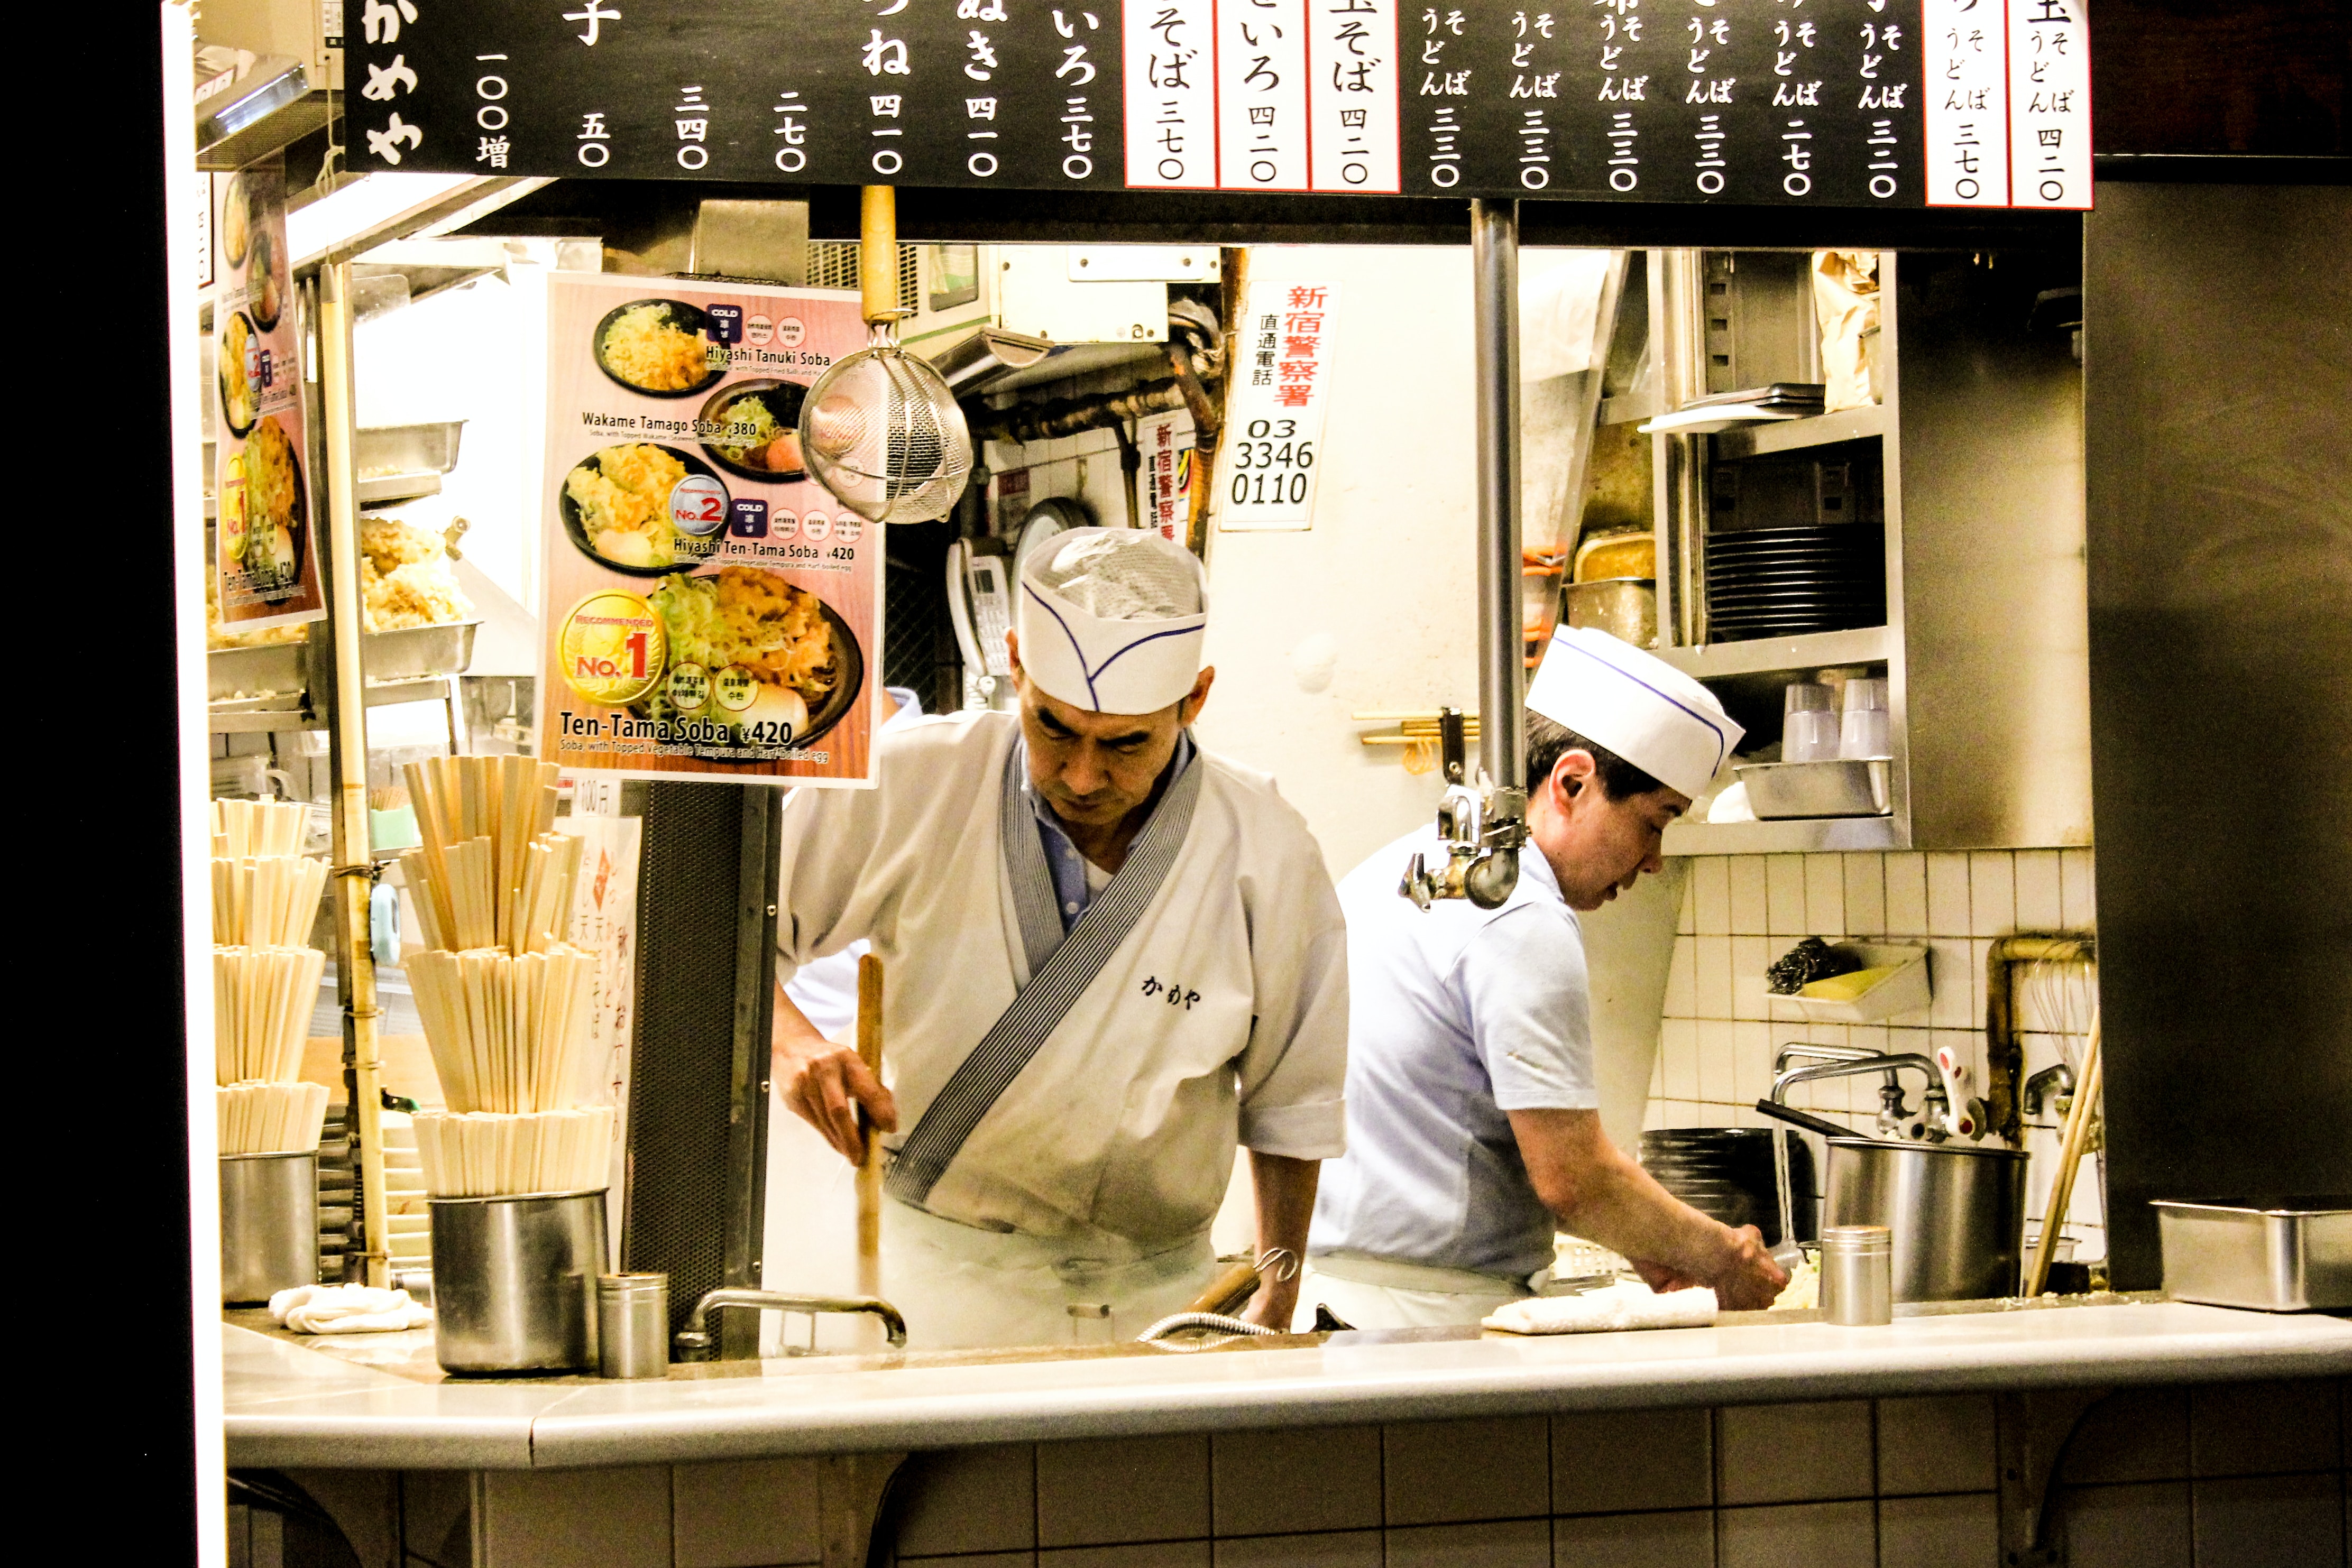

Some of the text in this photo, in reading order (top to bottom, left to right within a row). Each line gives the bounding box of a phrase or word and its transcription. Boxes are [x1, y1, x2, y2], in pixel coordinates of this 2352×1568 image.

[1150, 8, 1198, 180] そば 三七〇
[1240, 0, 1282, 182] いろ 四二〇
[1597, 14, 1622, 102] うどん
[1622, 16, 1649, 102] そば
[1686, 17, 1710, 104] うどん
[1708, 19, 1736, 104] そば
[1772, 20, 1796, 107] うどん
[1796, 21, 1823, 107] そば
[1858, 23, 1882, 109] うどん
[1881, 25, 1908, 109] そば
[1944, 27, 1965, 110] うどん
[1967, 30, 1990, 111] そば
[476, 54, 510, 168] 一〇〇増
[675, 86, 709, 170] 三四〇
[773, 91, 807, 172] 二七〇
[869, 94, 902, 174] 四一〇
[966, 97, 998, 177] 四一〇
[1420, 8, 1472, 188] そば うどん 三三〇
[1510, 11, 1561, 190] そば うどん 三三〇
[577, 113, 610, 168] 五〇
[1060, 97, 1094, 179] 三七〇
[1340, 108, 1370, 184] 四二〇
[1607, 113, 1638, 192] 三三〇
[1694, 115, 1725, 194] 三三〇
[1781, 120, 1812, 196] 二七〇
[1867, 120, 1897, 198] 三二〇
[1954, 124, 1980, 199] 三七〇
[2037, 128, 2065, 201] 四二〇
[711, 309, 739, 317] COLD
[1252, 315, 1280, 386] 直通電話
[1273, 286, 1329, 407] 新宿警察署
[706, 345, 830, 366] Hiyashi Tanuki Soba
[582, 412, 635, 428] Wakame
[640, 416, 688, 433] Tamago
[692, 419, 721, 433] Soba
[1235, 442, 1313, 469] 3346
[1247, 420, 1296, 438] 03
[675, 497, 722, 522] No.2
[1232, 473, 1307, 505] 0110
[674, 538, 720, 554] Hiyashi
[724, 540, 786, 557] Ten-Tama
[789, 545, 819, 558] Soba
[576, 633, 648, 677] No.1
[561, 712, 792, 744] Ten-Tama Soba ¥420
[588, 741, 608, 752] with
[612, 741, 645, 755] Topped
[647, 743, 694, 757] Vegetable
[696, 744, 736, 759] Tempura
[737, 746, 755, 758] and
[812, 751, 829, 763] egg
[1142, 976, 1200, 1010] かめや
